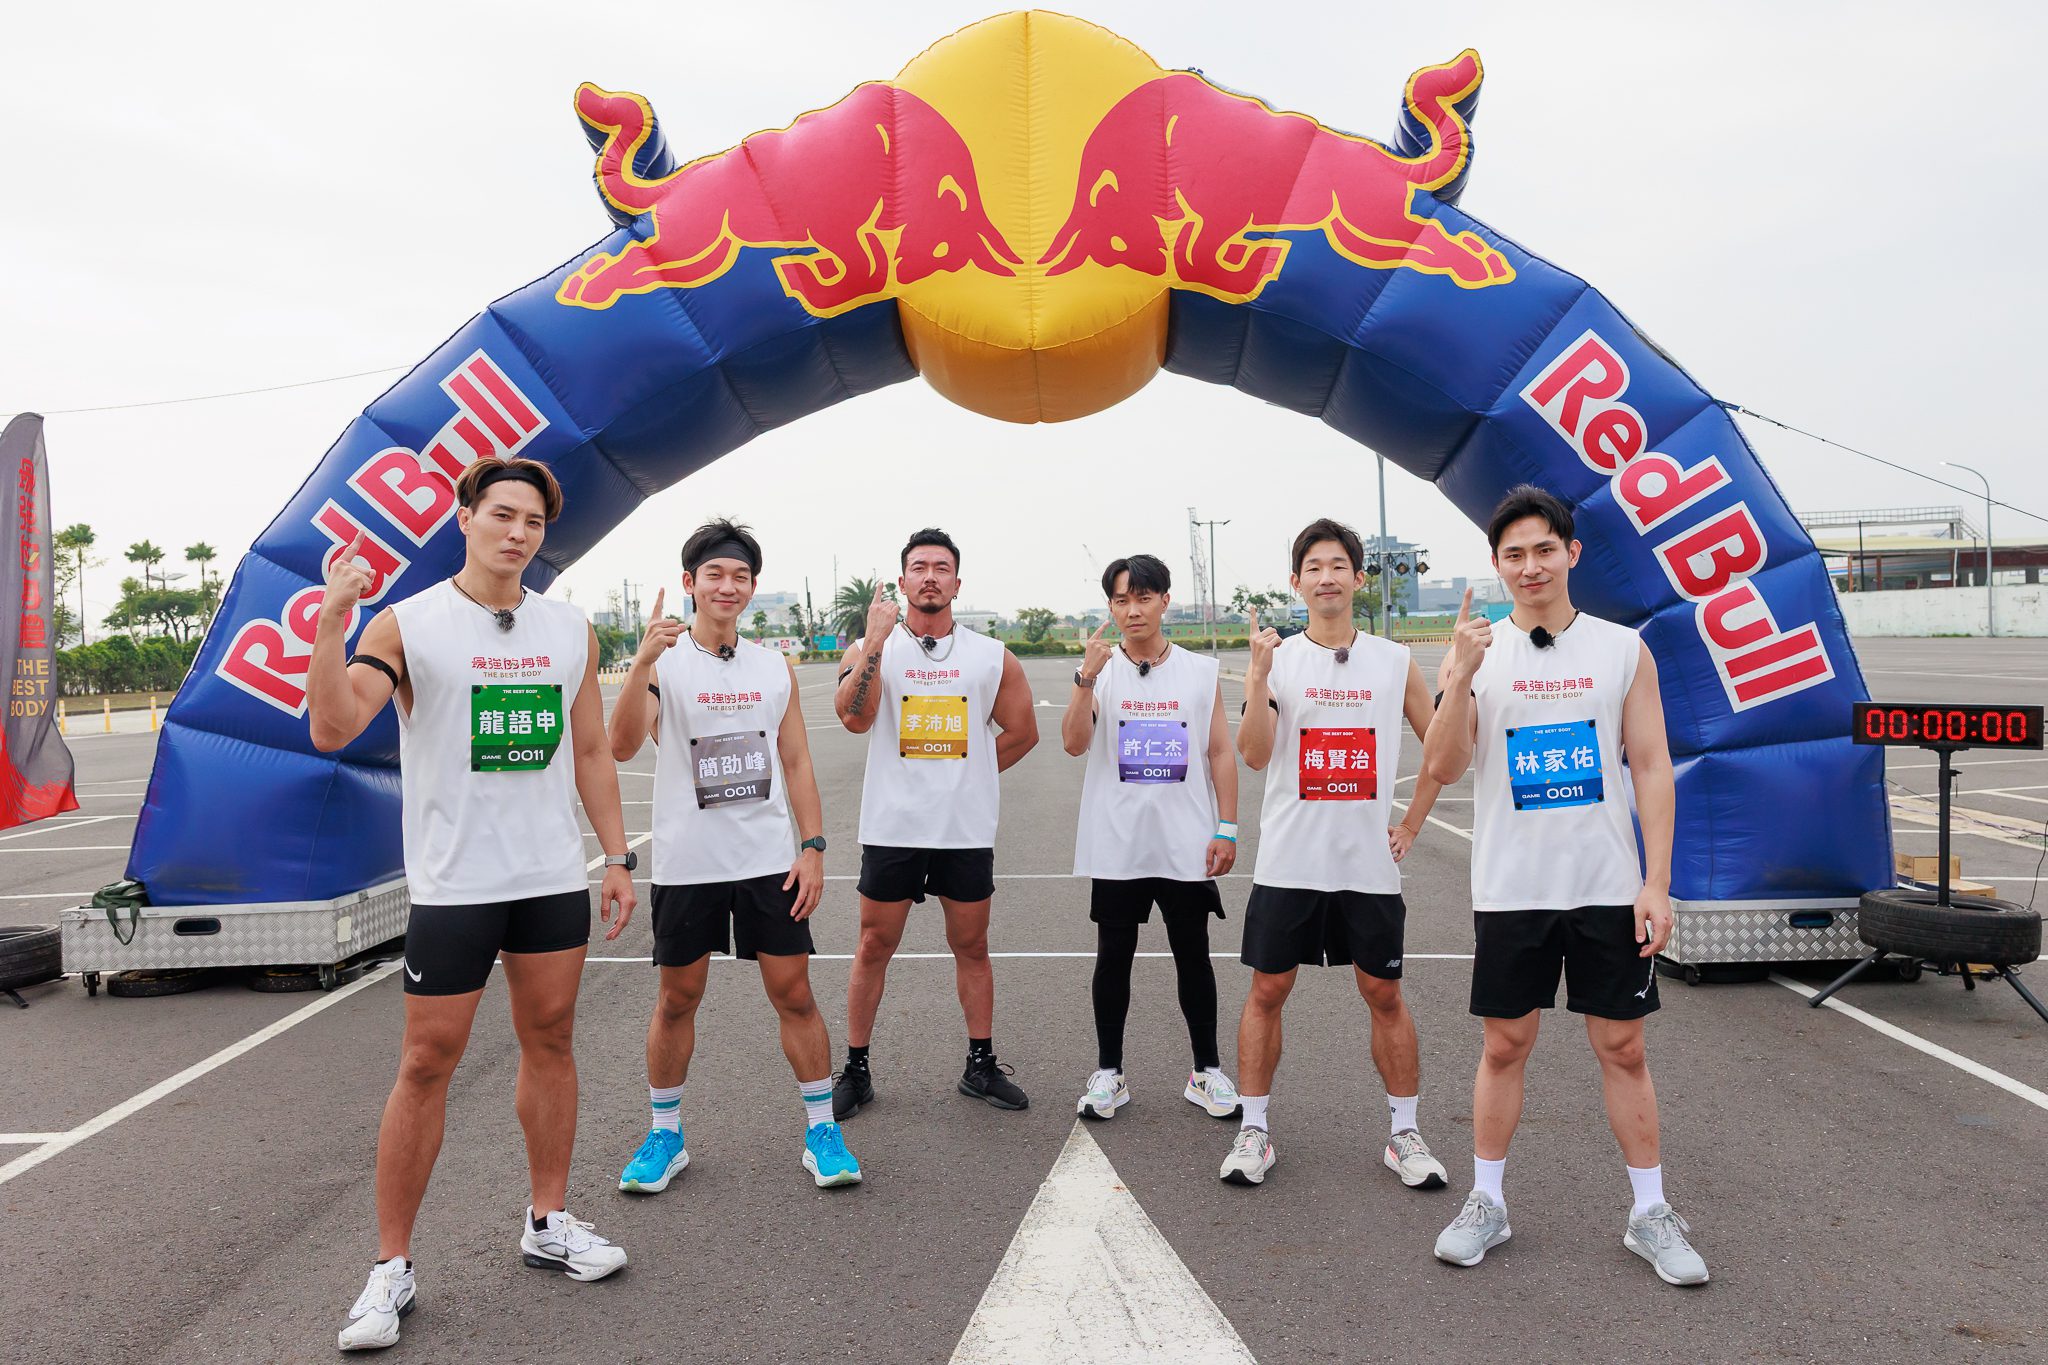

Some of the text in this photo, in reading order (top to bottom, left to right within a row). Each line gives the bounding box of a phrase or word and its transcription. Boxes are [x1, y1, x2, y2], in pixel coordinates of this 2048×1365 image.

[346, 348, 550, 548] Bull
[1519, 328, 1835, 713] Red Bull
[17, 659, 49, 675] THE
[471, 655, 551, 670] 最強的身體
[1512, 677, 1594, 692] 最強的身體
[478, 709, 556, 735] 龍語申
[905, 713, 962, 733] 李沛旭
[1866, 709, 2027, 742] 00:00:00
[507, 749, 544, 762] 0011
[923, 743, 952, 753] 0011
[1123, 738, 1182, 757] 許仁杰
[698, 751, 767, 778] 簡劭峰
[1304, 748, 1370, 770] 梅賢治
[1514, 745, 1595, 775] 林家佑
[1143, 768, 1171, 777] 0011
[724, 784, 757, 798] 0011
[1326, 782, 1358, 793] 0011
[1546, 785, 1584, 799] 0011
